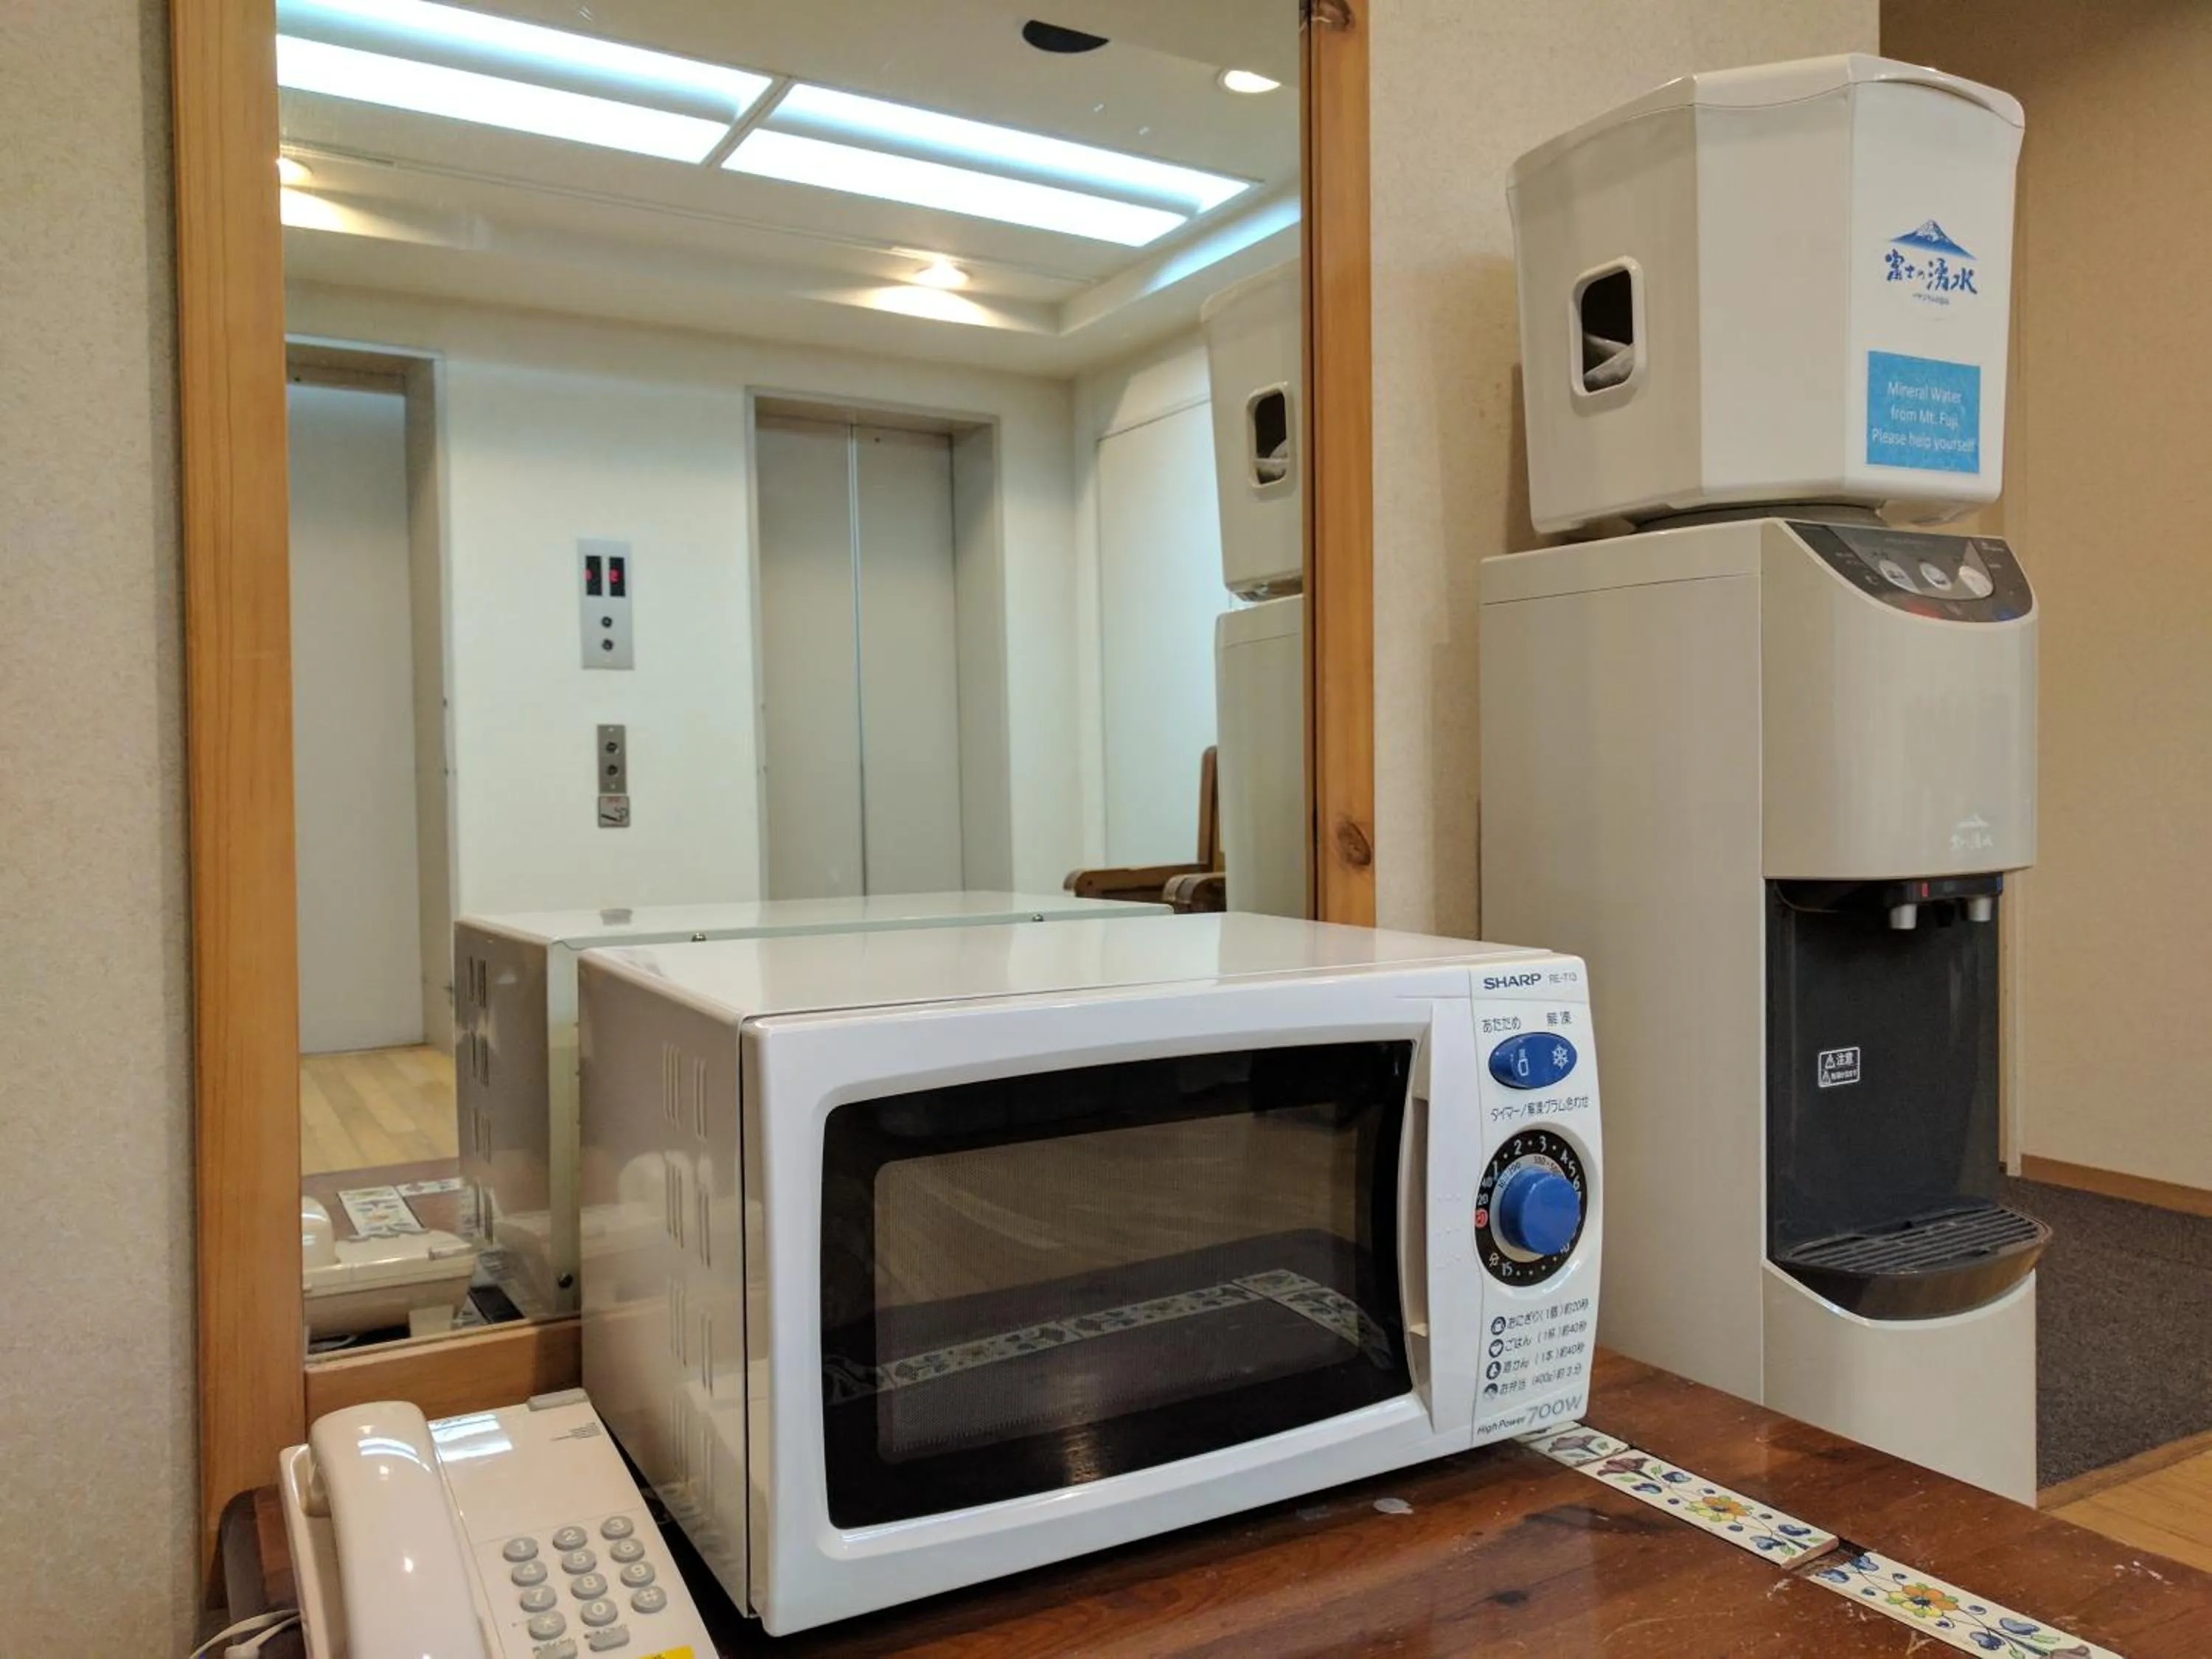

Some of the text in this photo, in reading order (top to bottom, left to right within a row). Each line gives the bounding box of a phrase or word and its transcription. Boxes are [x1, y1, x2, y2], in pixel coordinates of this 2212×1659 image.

[1888, 382, 1961, 403] Mineral Water
[1891, 405, 1916, 422] from
[1872, 428, 1906, 445] Please
[1910, 431, 1931, 449] help
[1484, 973, 1541, 990] SHARP
[1514, 1139, 1521, 1155] 2
[1539, 1135, 1547, 1152] 3
[1560, 1148, 1568, 1165] 4
[1568, 1160, 1576, 1177] 5
[1573, 1176, 1581, 1192] 6
[1478, 1194, 1489, 1206] 20
[1502, 1263, 1513, 1276] 15
[1477, 1395, 1582, 1435] High Power 700W
[611, 1518, 625, 1530] 3
[563, 1528, 578, 1542] 2
[517, 1540, 526, 1553] 1
[572, 1552, 586, 1565] 5
[521, 1562, 537, 1576] 4
[630, 1564, 645, 1577] 9
[582, 1575, 595, 1588] 8
[530, 1587, 546, 1602] 7
[591, 1601, 606, 1615] 0
